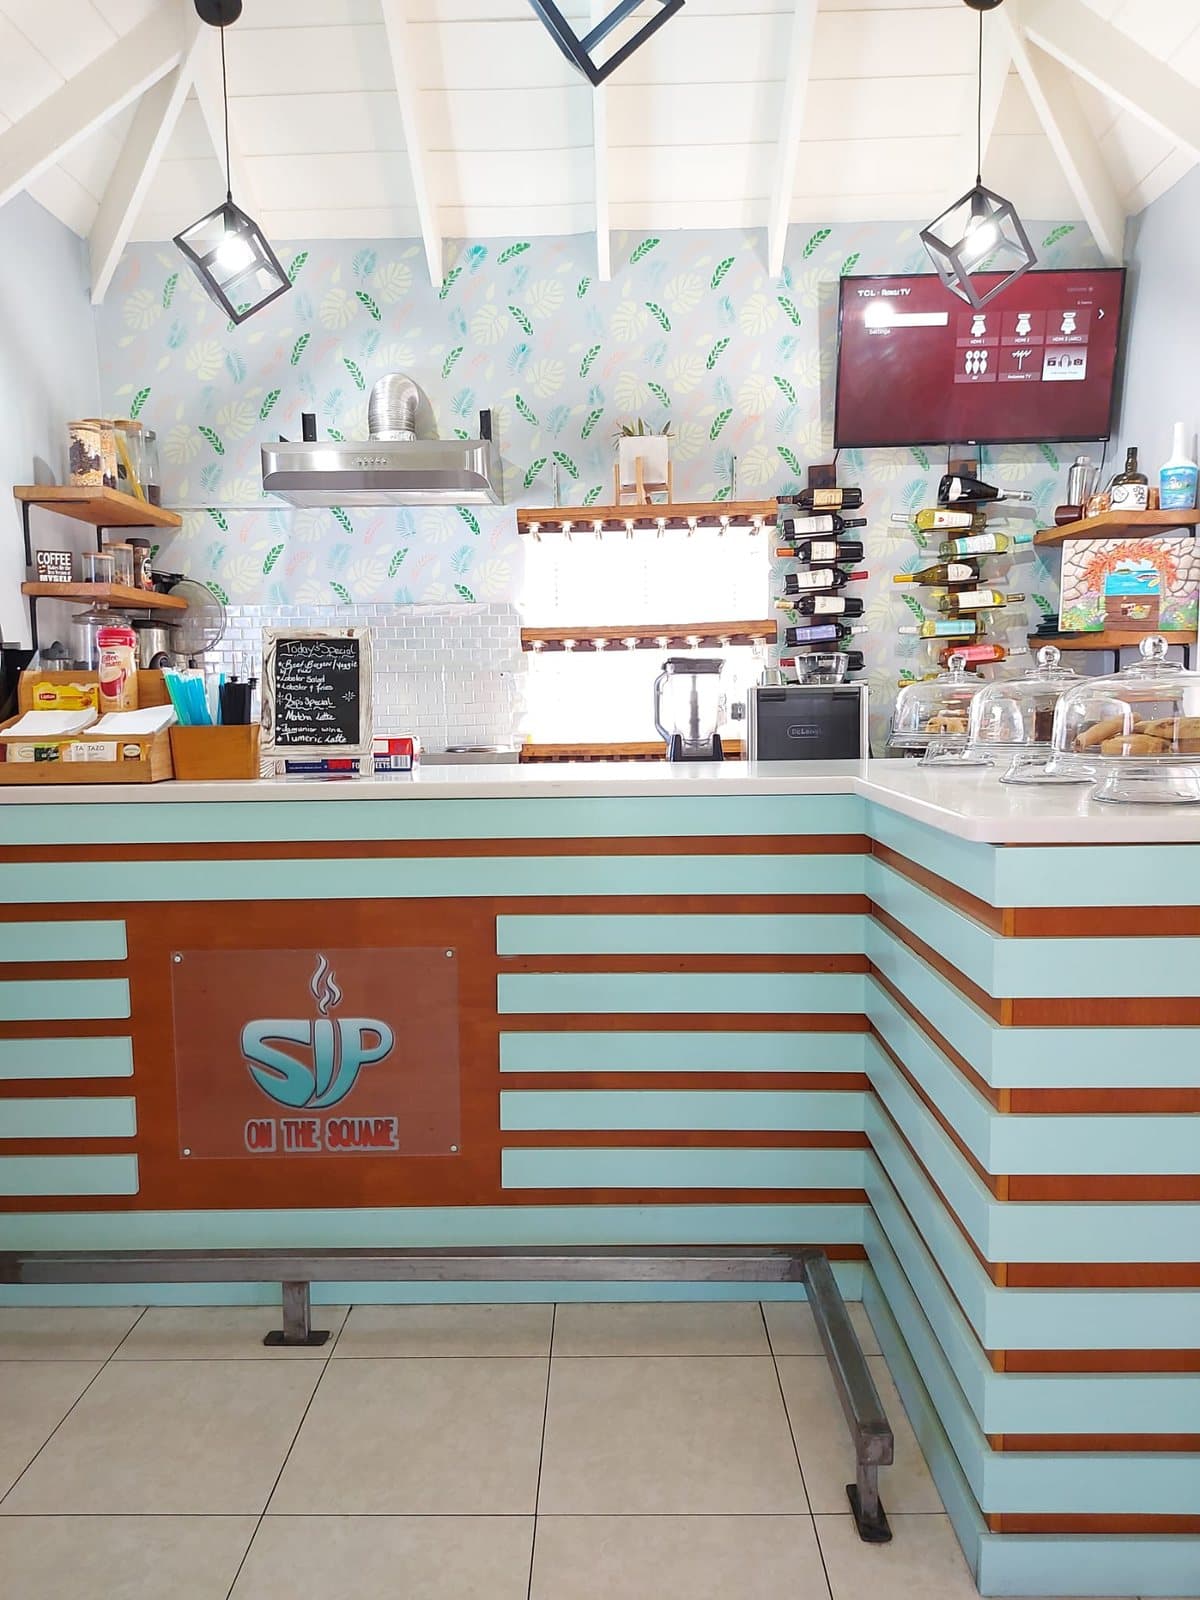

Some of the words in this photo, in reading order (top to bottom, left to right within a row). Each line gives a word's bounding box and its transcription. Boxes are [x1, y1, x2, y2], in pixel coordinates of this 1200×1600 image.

[37, 552, 71, 566] COFFEE
[320, 643, 357, 657] Special
[242, 1018, 394, 1109] SIP
[246, 1119, 275, 1151] ON
[282, 1119, 321, 1151] THE
[326, 1118, 399, 1150] SQUARE
